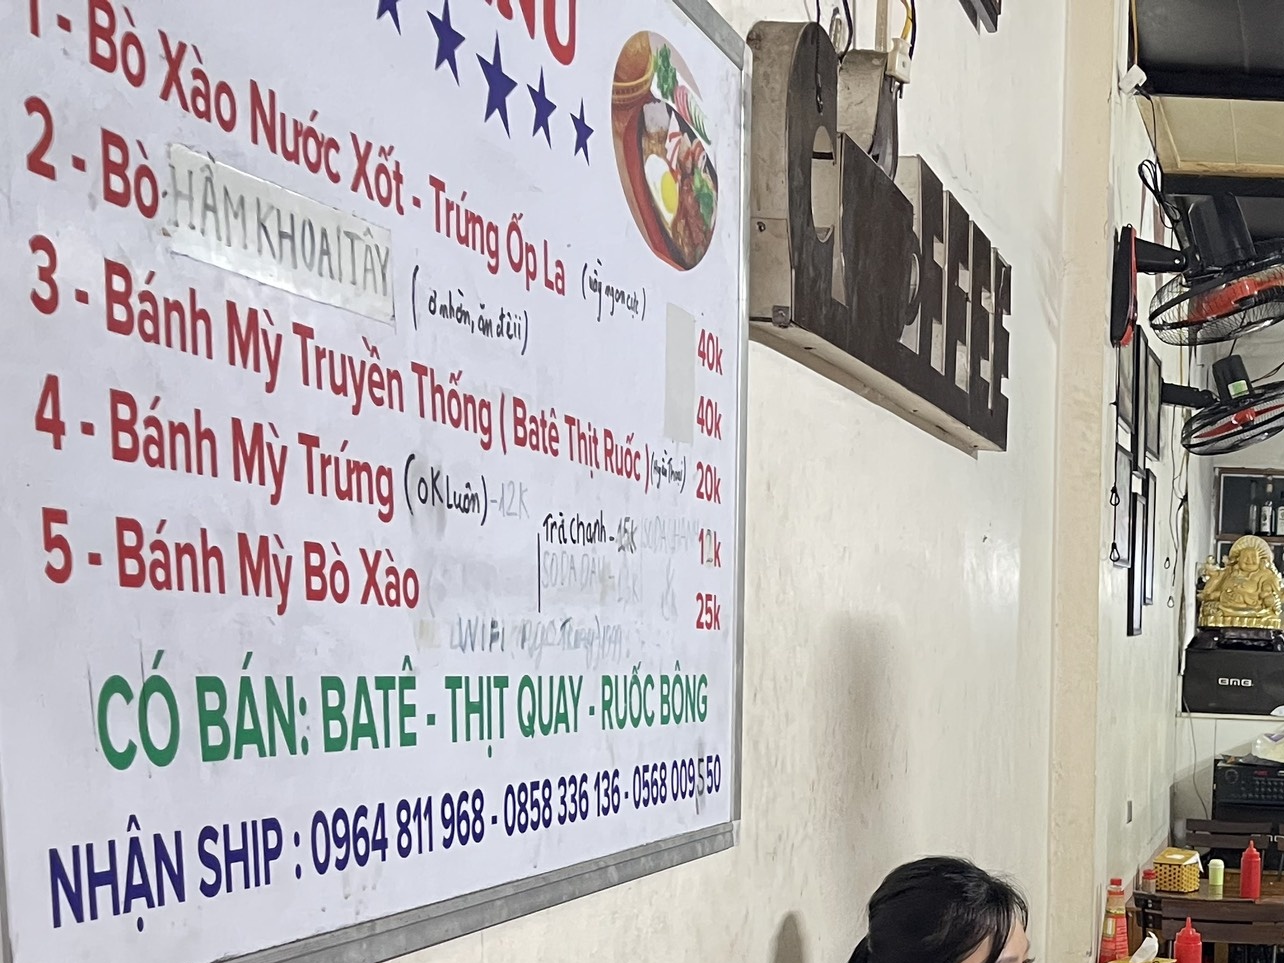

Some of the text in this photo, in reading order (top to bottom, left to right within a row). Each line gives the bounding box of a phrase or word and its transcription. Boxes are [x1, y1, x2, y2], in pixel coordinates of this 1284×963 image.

[24, 96, 57, 182] 2
[101, 127, 160, 220] Bò
[88, 0, 147, 88] Bò
[158, 29, 238, 133] Xào
[250, 79, 341, 184] Nước
[350, 132, 405, 216] Xốt
[429, 174, 500, 276] Trứng
[506, 213, 538, 291] Ốp
[544, 239, 566, 297] La
[255, 196, 344, 284] KHOAI
[344, 227, 391, 298] TÂY
[29, 234, 60, 315] 3
[104, 257, 214, 360] Bánh
[226, 299, 283, 394] Mỳ
[292, 321, 404, 416] Truyền
[411, 361, 492, 451] Thống
[564, 414, 601, 479] Thịt
[478, 303, 494, 338] ăn
[697, 328, 723, 376] 40k
[35, 373, 66, 450] 4
[110, 388, 218, 478] Bánh
[231, 417, 288, 506] Mỳ
[298, 432, 394, 522] Trứng
[696, 396, 722, 441] 40k
[543, 512, 567, 545] Trà
[696, 462, 722, 505] 20k
[42, 507, 73, 584] 5
[115, 516, 225, 594] Bánh
[237, 531, 293, 616] Mỳ
[304, 541, 350, 604] Bò
[359, 548, 419, 609] Xào
[695, 592, 721, 630] 25k
[98, 650, 181, 770] CÓ
[195, 652, 309, 764] BÁN:
[320, 655, 417, 753] BATÊ
[445, 676, 509, 759] THỊT
[517, 674, 584, 738] QUAY
[601, 662, 656, 730] RUỐC
[660, 660, 709, 726] BÔNG
[49, 814, 187, 932] NHẬN
[198, 817, 284, 898] SHIP
[310, 802, 389, 876] 0964
[396, 796, 434, 858] 811
[440, 788, 485, 849] 968
[504, 779, 552, 837] 0858
[557, 773, 589, 825] 336
[594, 769, 621, 817] 136
[632, 762, 668, 810] 0568
